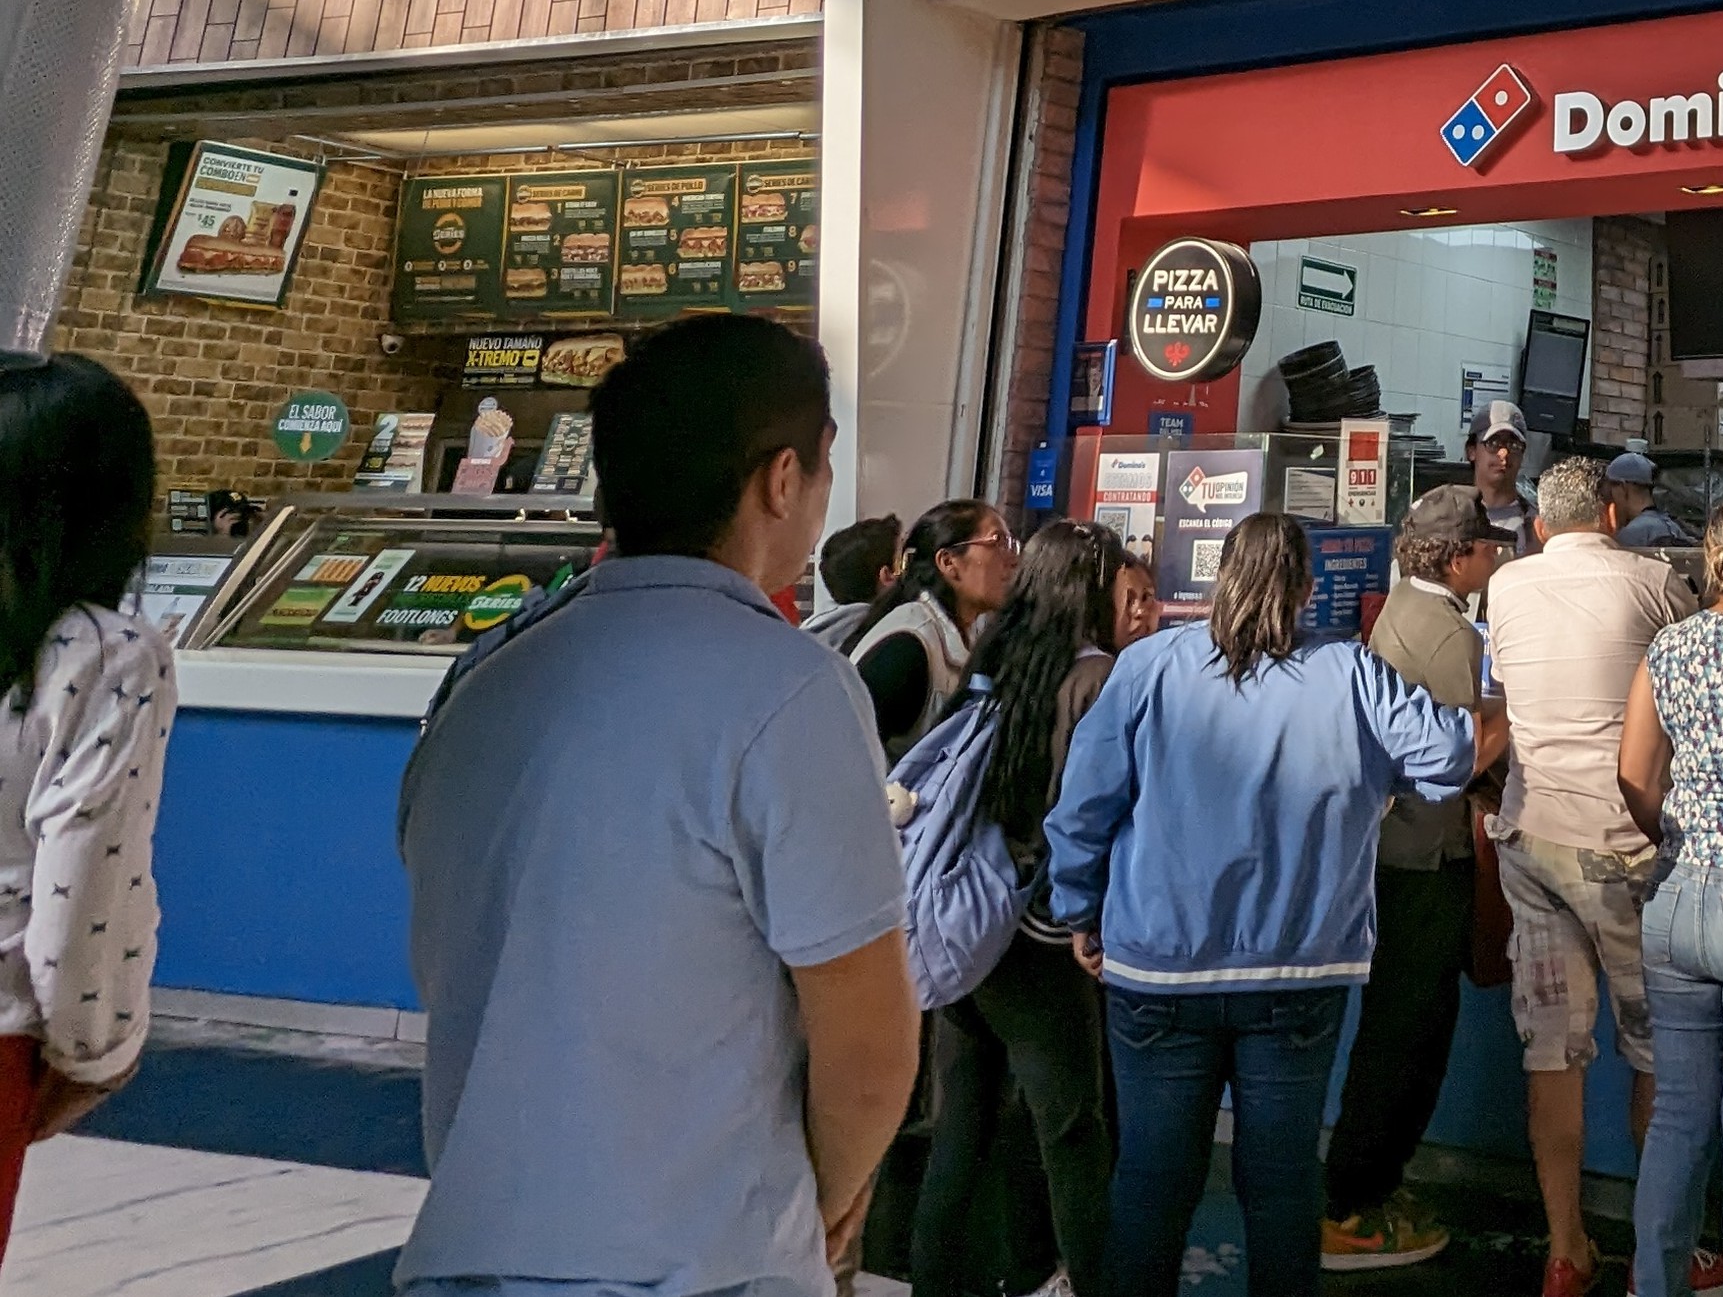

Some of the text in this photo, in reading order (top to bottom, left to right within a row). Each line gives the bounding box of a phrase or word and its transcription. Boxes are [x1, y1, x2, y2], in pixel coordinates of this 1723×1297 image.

[202, 157, 265, 174] CONVIERTE TU
[200, 166, 235, 181] COMBO
[672, 196, 680, 207] 4
[790, 192, 797, 204] 7
[553, 235, 561, 246] 2
[551, 268, 559, 279] 3
[1153, 268, 1219, 292] PIZZA
[1164, 297, 1203, 309] PARA
[1143, 314, 1218, 334] LLEVAR
[469, 335, 543, 349] NUEVO TAMAÑO
[465, 349, 520, 367] X-TREMO
[289, 404, 337, 420] EL SABOR
[278, 417, 343, 433] COMIENZA AQUÍ
[374, 414, 399, 439] 2
[1160, 417, 1184, 428] TEAM
[1118, 459, 1146, 469] Domino's
[1105, 472, 1152, 489] ESTAMOS
[1030, 485, 1053, 497] VISA
[1103, 492, 1152, 502] CONTRATANDO
[1202, 479, 1244, 500] TU OPINIÓN
[1179, 517, 1233, 528] ESCANEA EL CÓDIGO
[403, 575, 486, 592] 12 NUEVOS
[376, 608, 459, 626] FOOTLONGS
